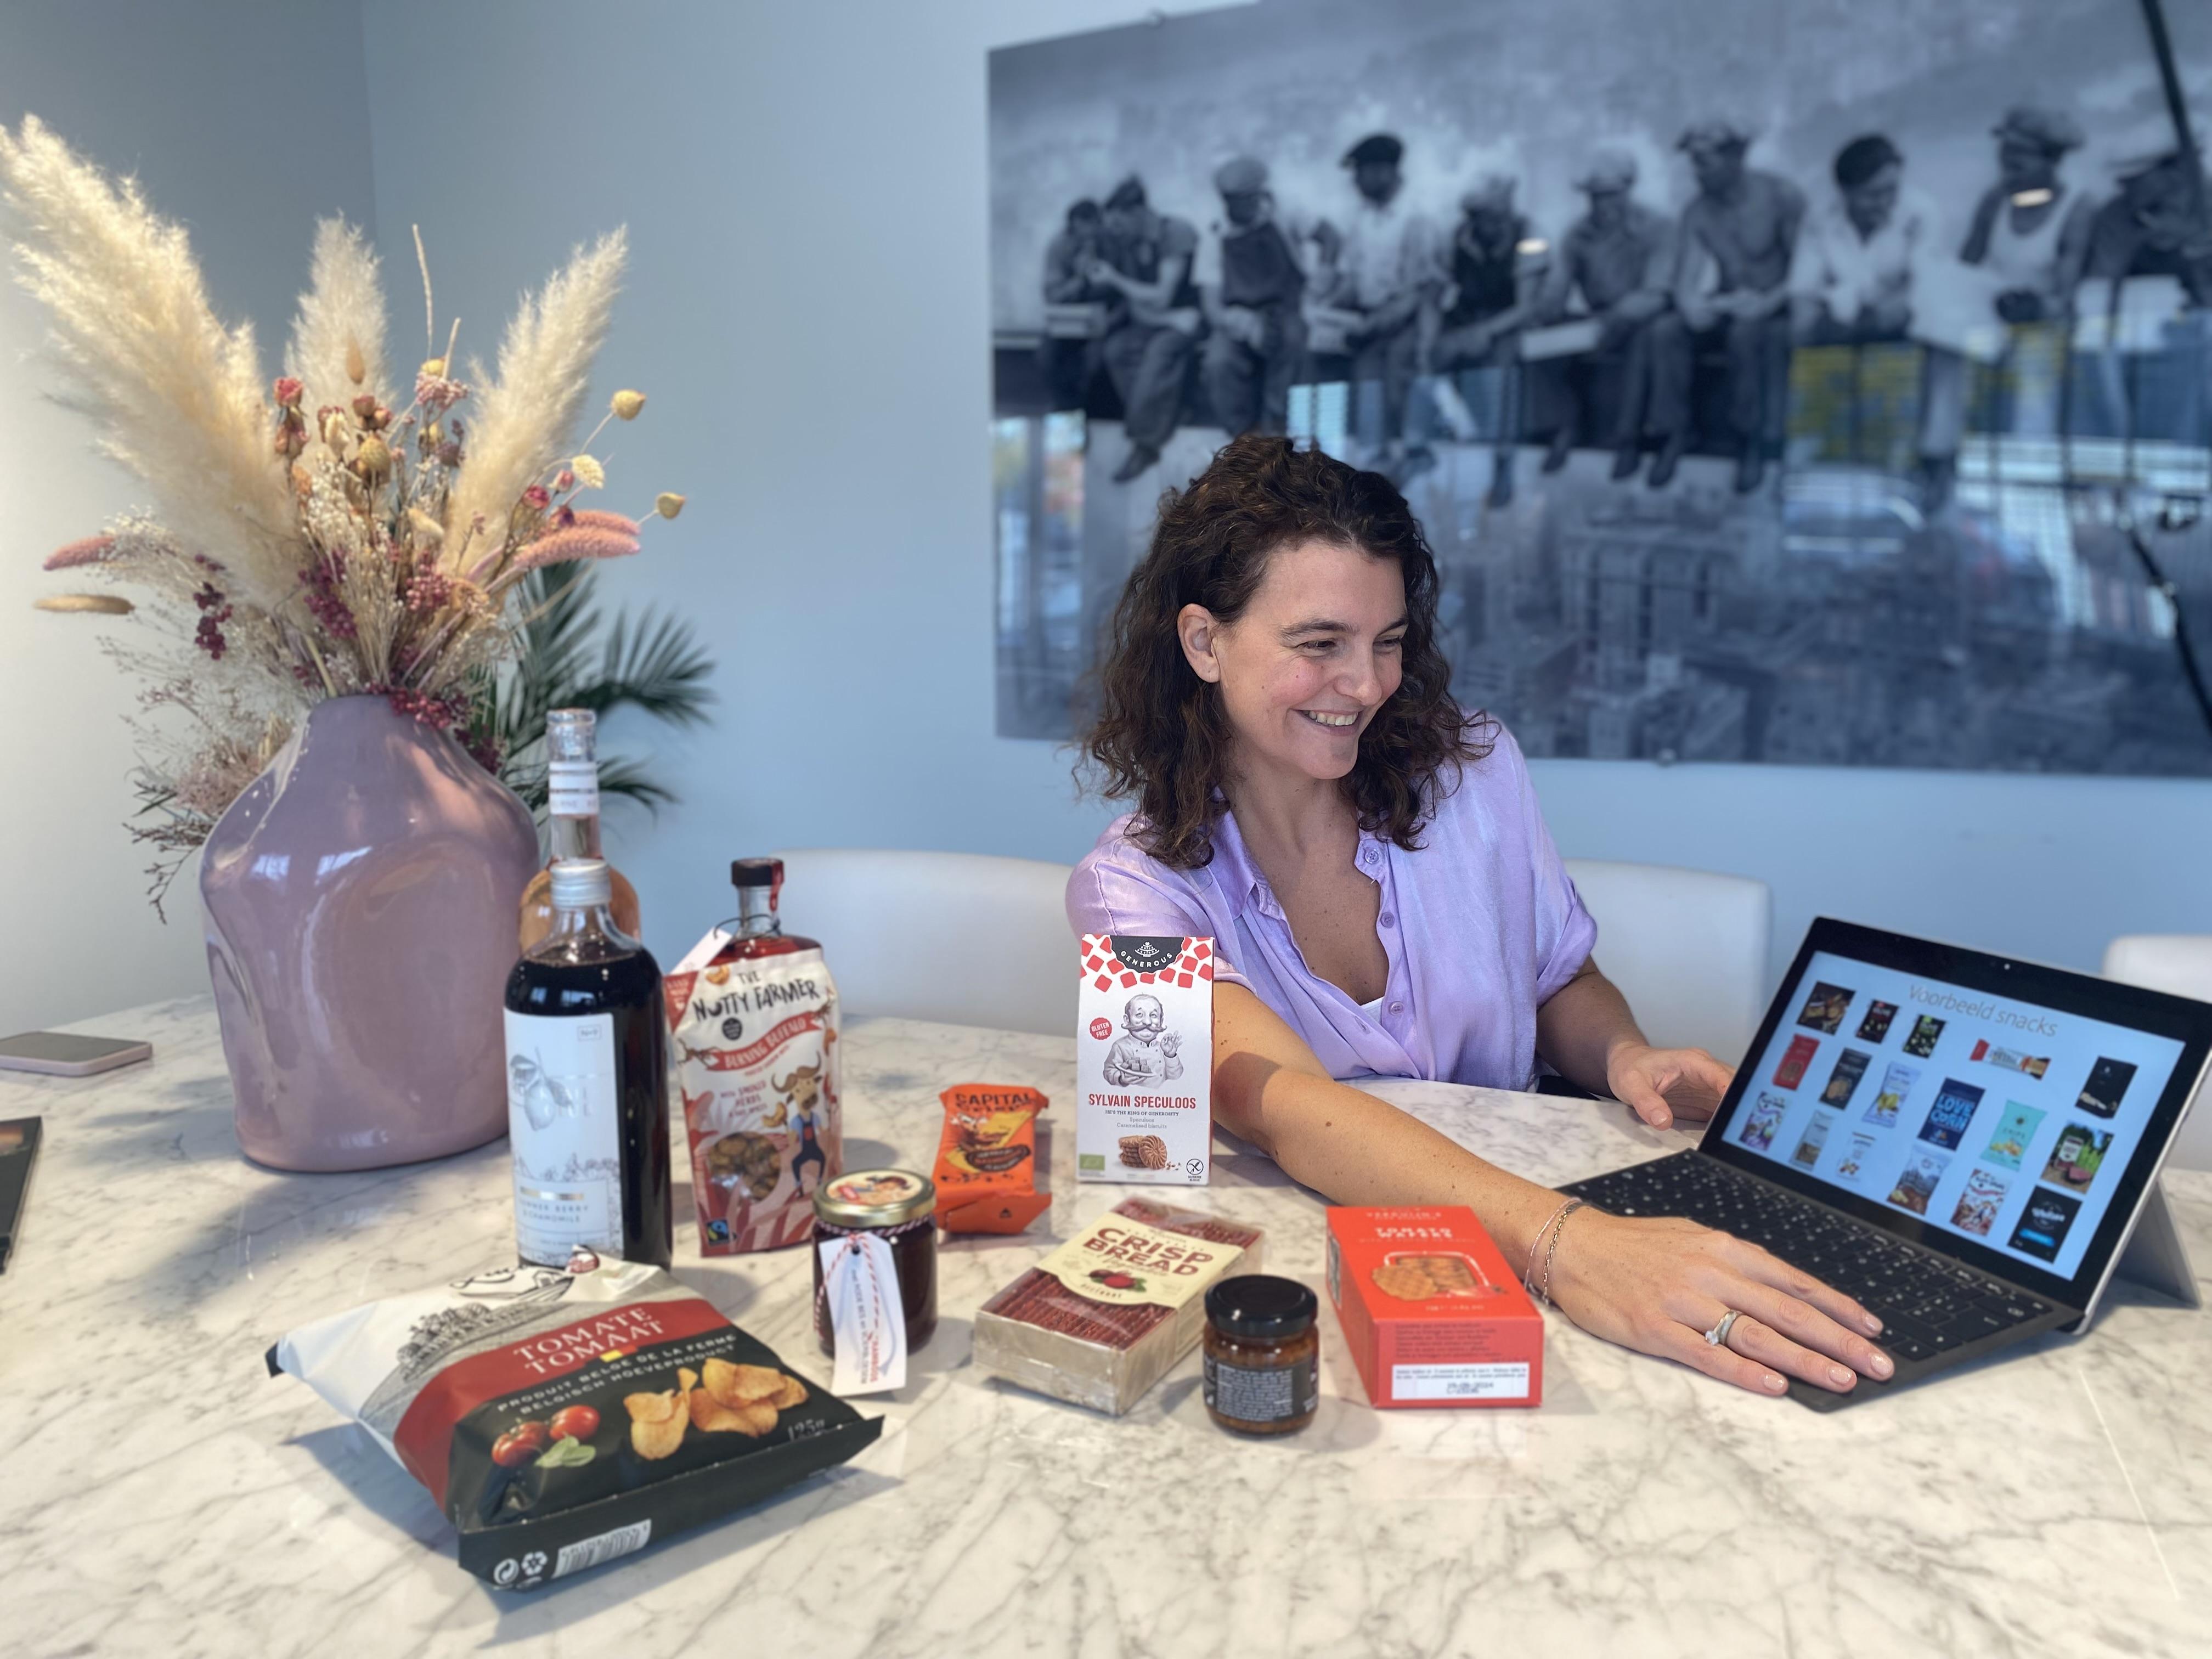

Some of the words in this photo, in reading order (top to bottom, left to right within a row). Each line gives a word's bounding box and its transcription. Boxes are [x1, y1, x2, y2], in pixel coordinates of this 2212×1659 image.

[1121, 951, 1172, 967] GENEROUS
[692, 992, 750, 1022] NUTTY
[753, 978, 821, 1011] FARMER
[1909, 984, 1995, 1020] Voorbeeld
[1995, 1009, 2058, 1037] snacks
[1091, 1022, 1110, 1032] GLUTEN
[1096, 1030, 1109, 1038] FREE
[1088, 1093, 1131, 1107] SYLVAIN
[1134, 1096, 1196, 1109] SPECULOOS
[1931, 1109, 1968, 1131] CORN
[1936, 1094, 1974, 1117] LOVE
[1083, 1237, 1199, 1276] BREAD
[1097, 1227, 1214, 1264] CRISP
[513, 1308, 652, 1360] TOMATE
[524, 1320, 663, 1374] TOMAAT
[498, 1381, 571, 1412] PRODUIT
[579, 1359, 631, 1383] BELGE
[636, 1352, 658, 1363] DE
[662, 1347, 682, 1358] LA
[686, 1334, 736, 1351] FERME
[520, 1380, 605, 1415] BELGISCH
[611, 1344, 733, 1382] HOEVEPRODUCT
